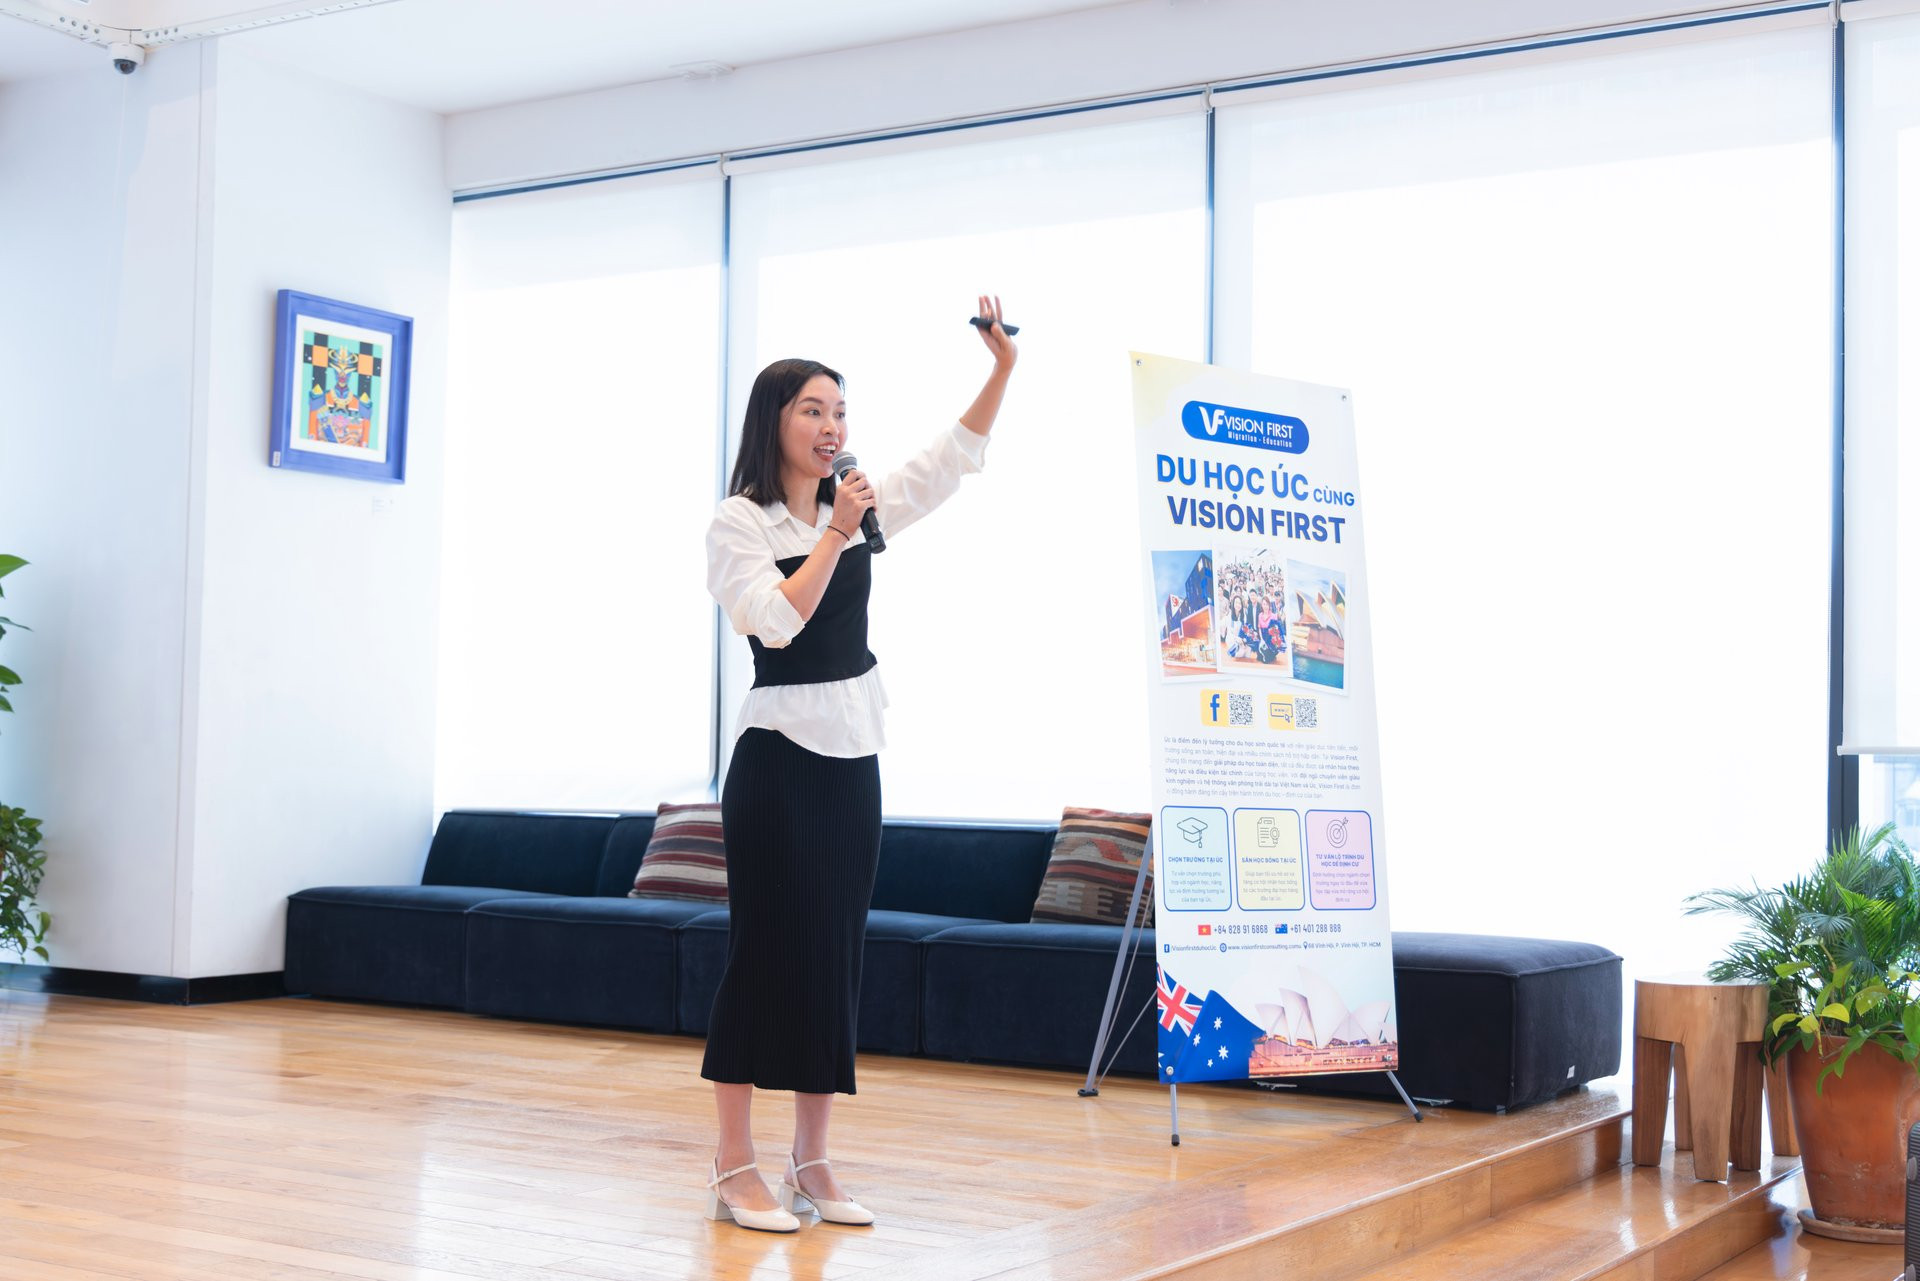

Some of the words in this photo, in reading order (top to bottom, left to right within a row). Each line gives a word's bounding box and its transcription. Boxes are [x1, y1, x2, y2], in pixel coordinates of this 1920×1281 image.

[1224, 415, 1264, 435] VISION
[1266, 422, 1293, 440] FIRST
[1263, 436, 1292, 448] Education
[1157, 454, 1196, 486] DU
[1204, 460, 1264, 500] HỌC
[1272, 464, 1308, 501] ÚC
[1313, 486, 1355, 506] CÙNG
[1167, 496, 1264, 535] VISION
[1271, 509, 1345, 544] FIRST
[1214, 925, 1226, 934] +84
[1228, 925, 1241, 934] 828
[1243, 925, 1249, 934] 91
[1252, 925, 1268, 934] 6868
[1291, 924, 1301, 933] +61
[1303, 924, 1314, 933] 401
[1316, 924, 1327, 932] 288
[1330, 924, 1341, 932] 888
